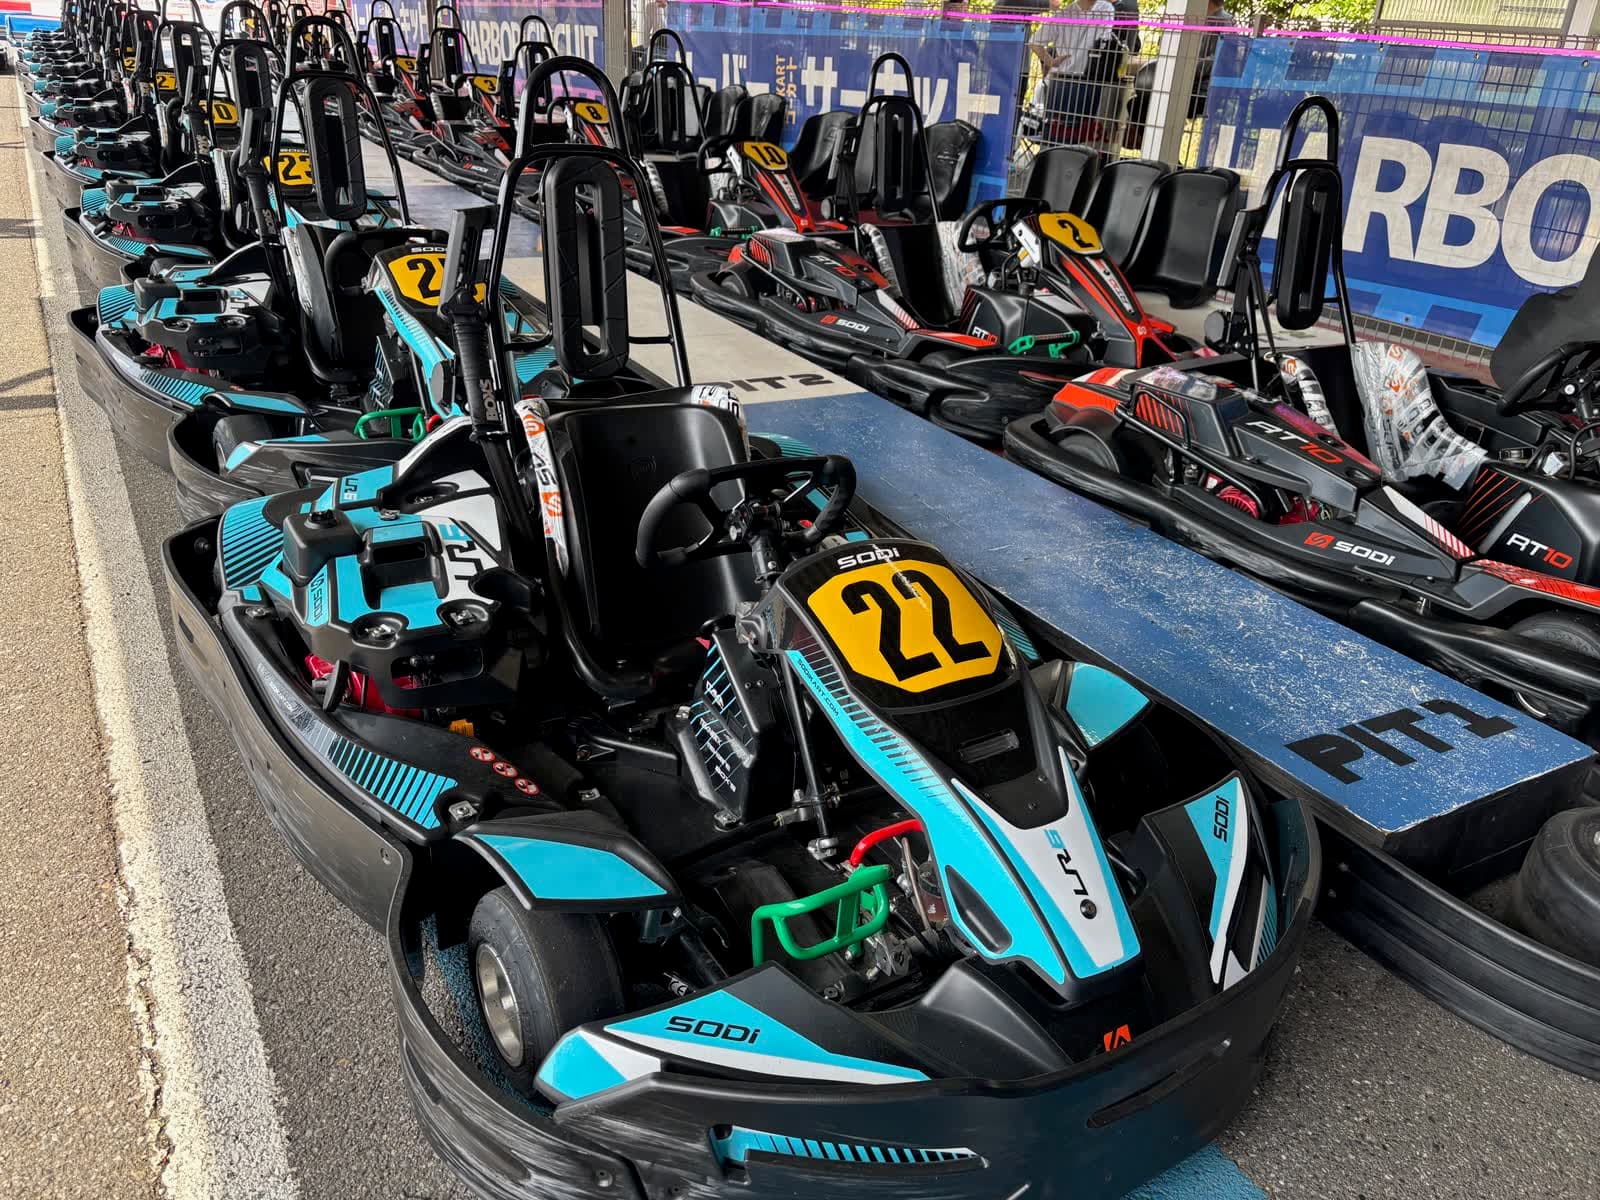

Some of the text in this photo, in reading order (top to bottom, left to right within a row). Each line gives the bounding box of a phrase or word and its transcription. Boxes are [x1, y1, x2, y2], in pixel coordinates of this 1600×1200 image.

[586, 105, 602, 120] 8
[752, 145, 786, 166] 10
[1057, 218, 1095, 249] 2
[1333, 540, 1396, 566] SODI
[1506, 533, 1574, 569] RT10
[841, 569, 992, 682] 22
